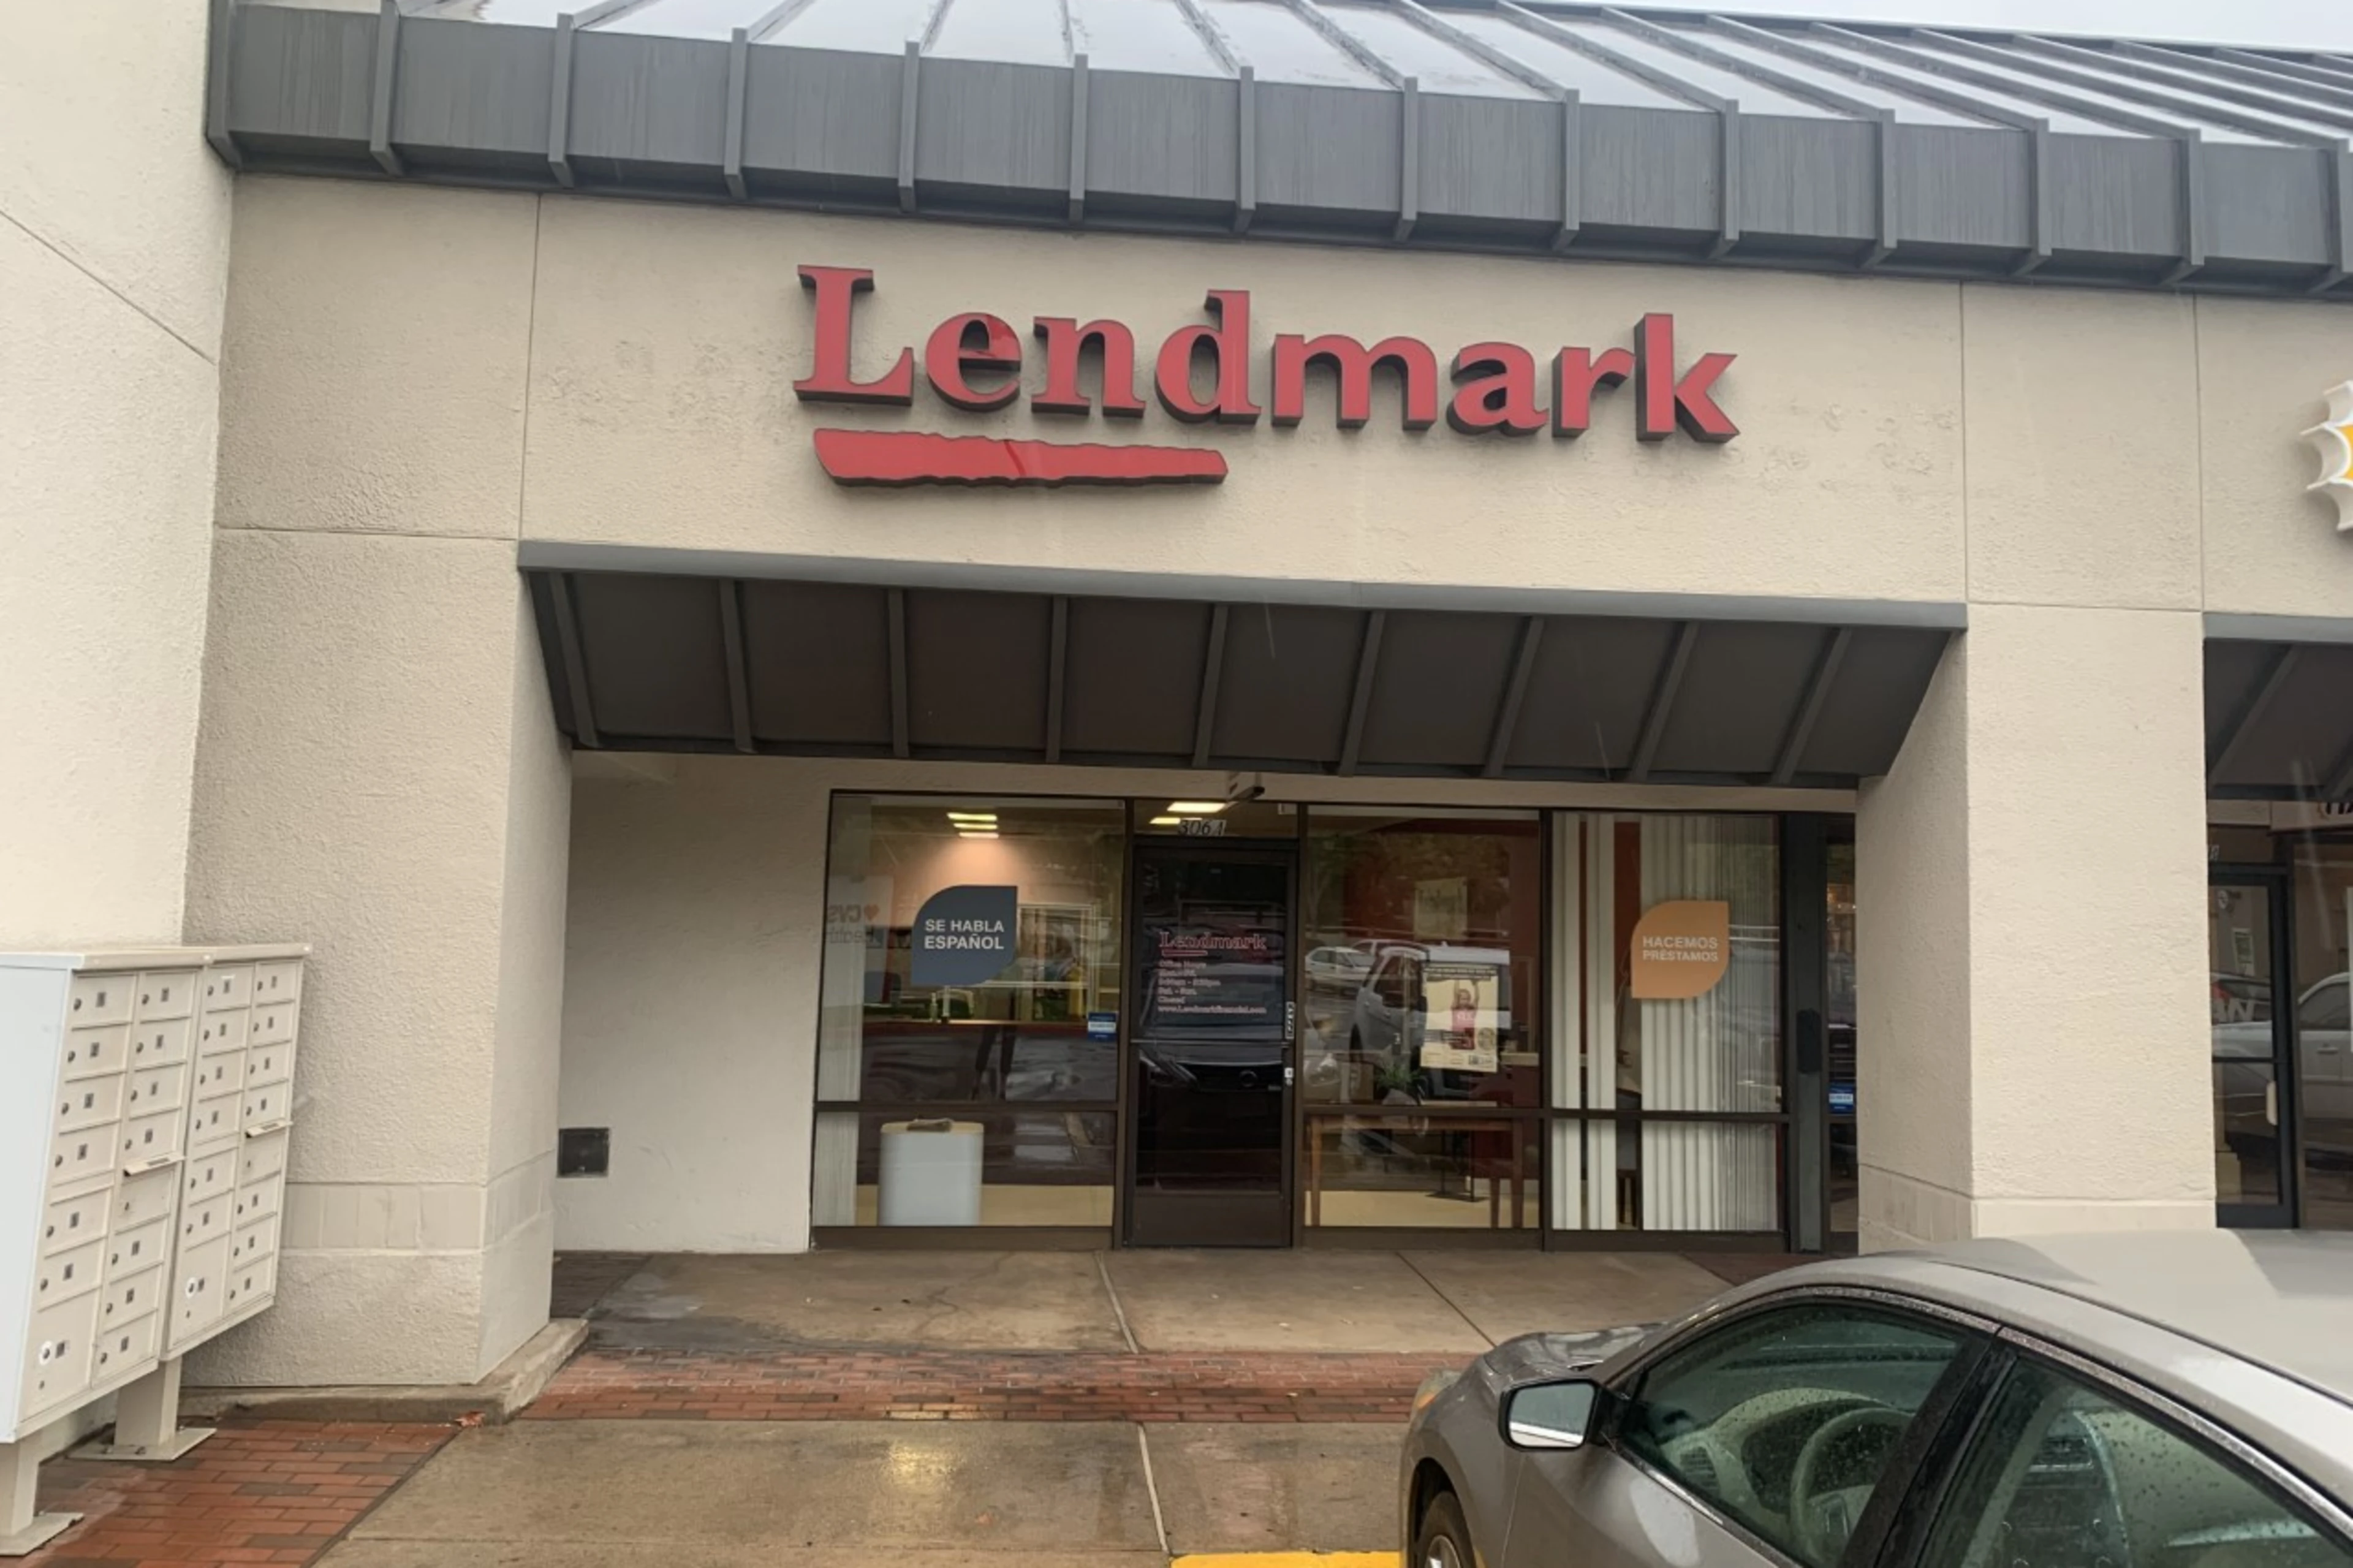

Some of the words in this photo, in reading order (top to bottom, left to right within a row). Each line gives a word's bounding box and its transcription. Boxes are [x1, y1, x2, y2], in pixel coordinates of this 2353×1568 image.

[794, 265, 1741, 443] Lendmark
[925, 919, 945, 932] SE
[950, 920, 1004, 933] HABLA
[924, 933, 1004, 949] ESPAÑOL
[1159, 931, 1267, 950] Lendmark
[1642, 935, 1718, 950] HACEMOS
